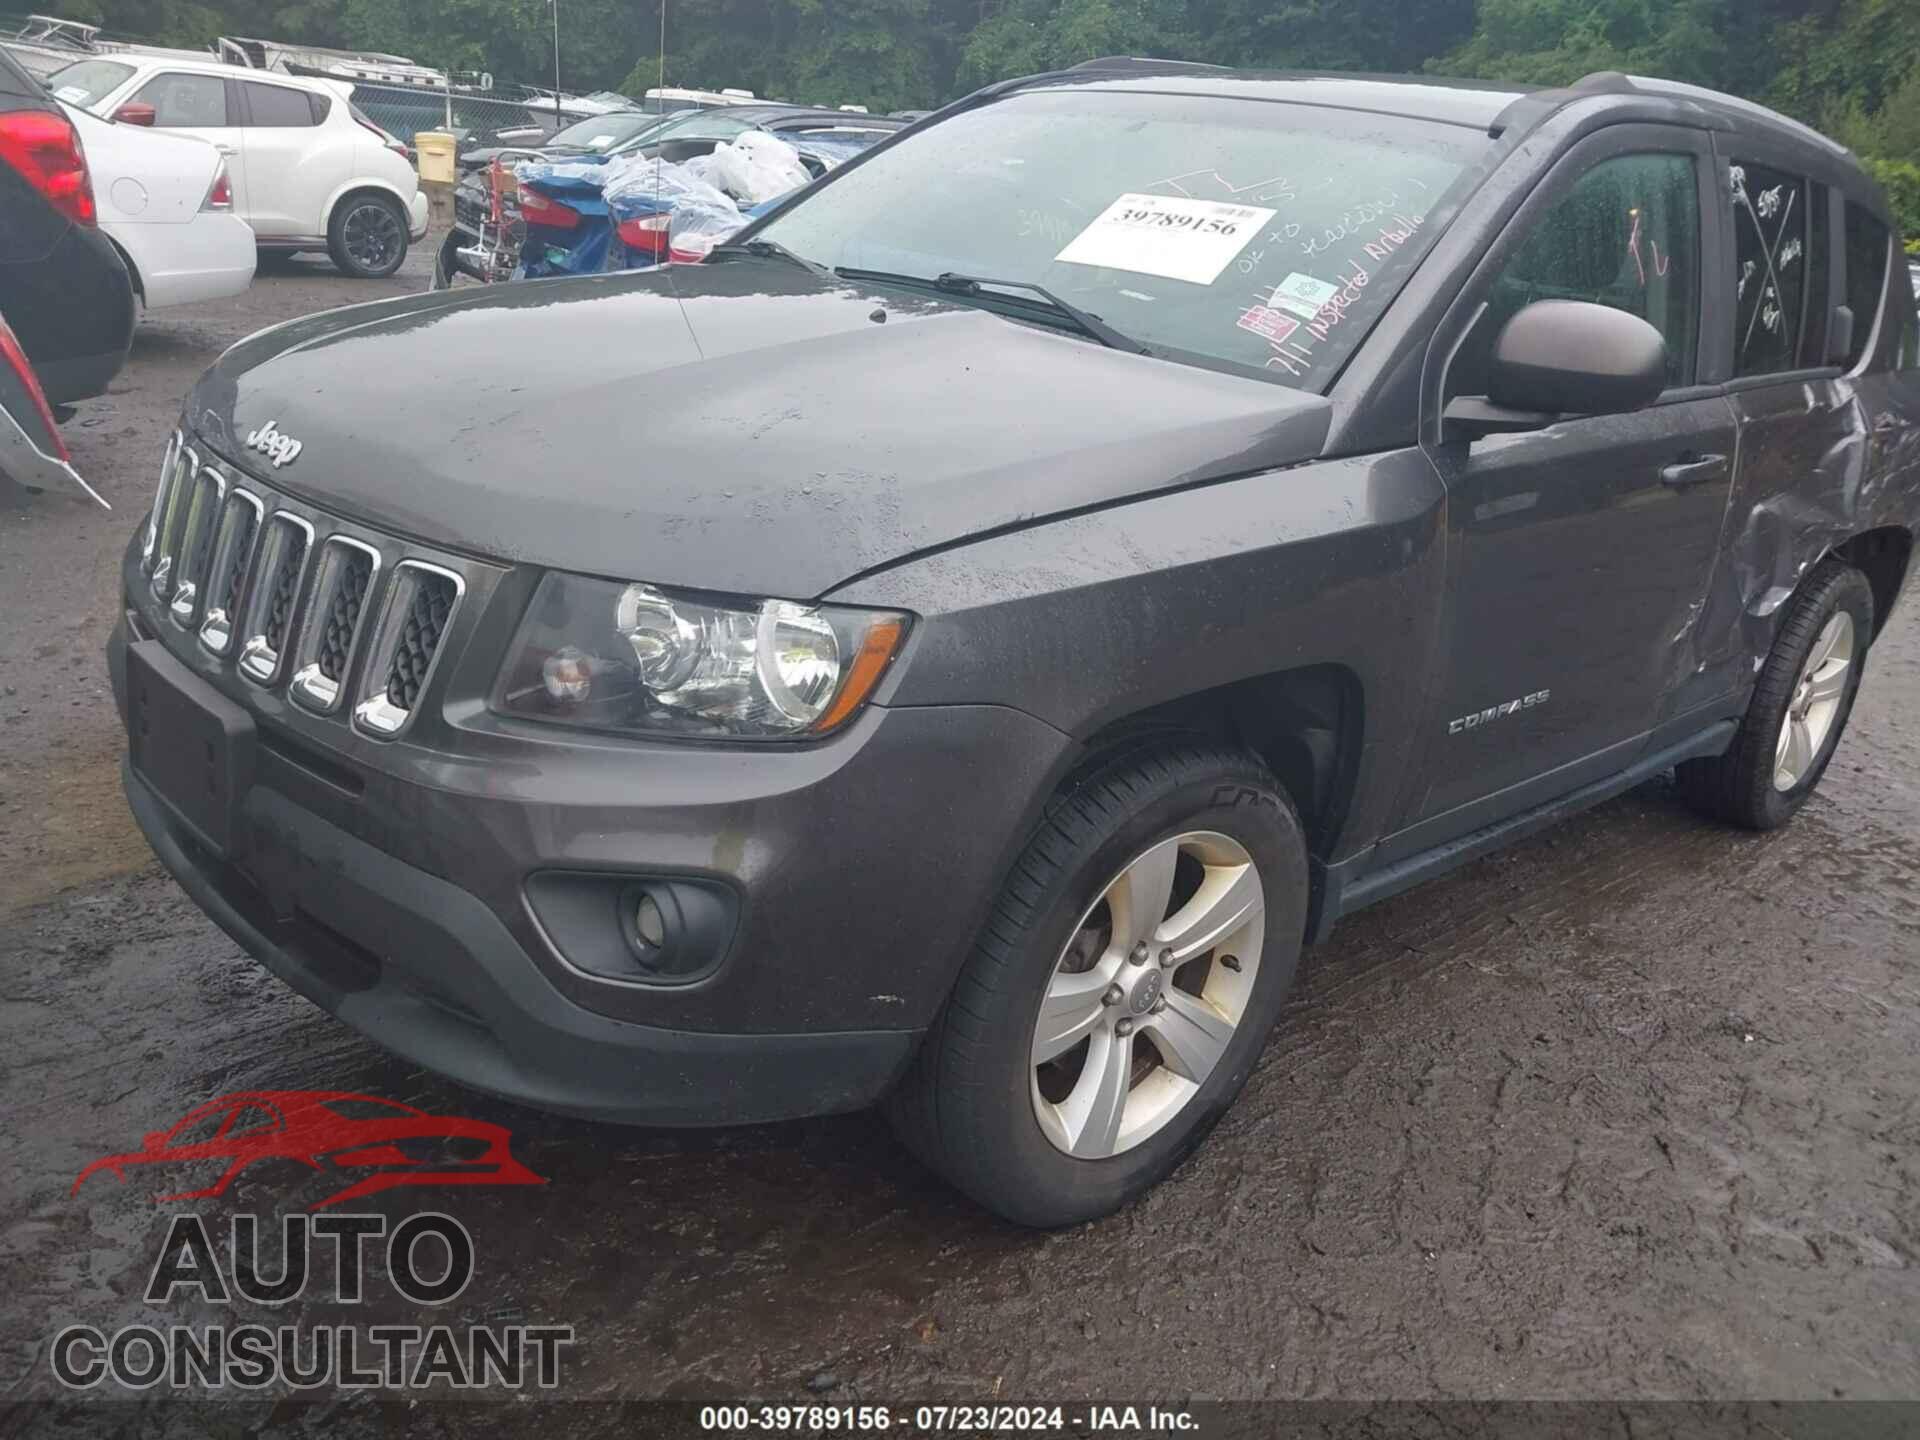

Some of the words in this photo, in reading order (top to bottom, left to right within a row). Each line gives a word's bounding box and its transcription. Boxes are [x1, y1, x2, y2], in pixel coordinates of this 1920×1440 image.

[1113, 208, 1237, 236] 39789156
[247, 420, 303, 469] Jeep
[1448, 689, 1550, 735] COMPASS
